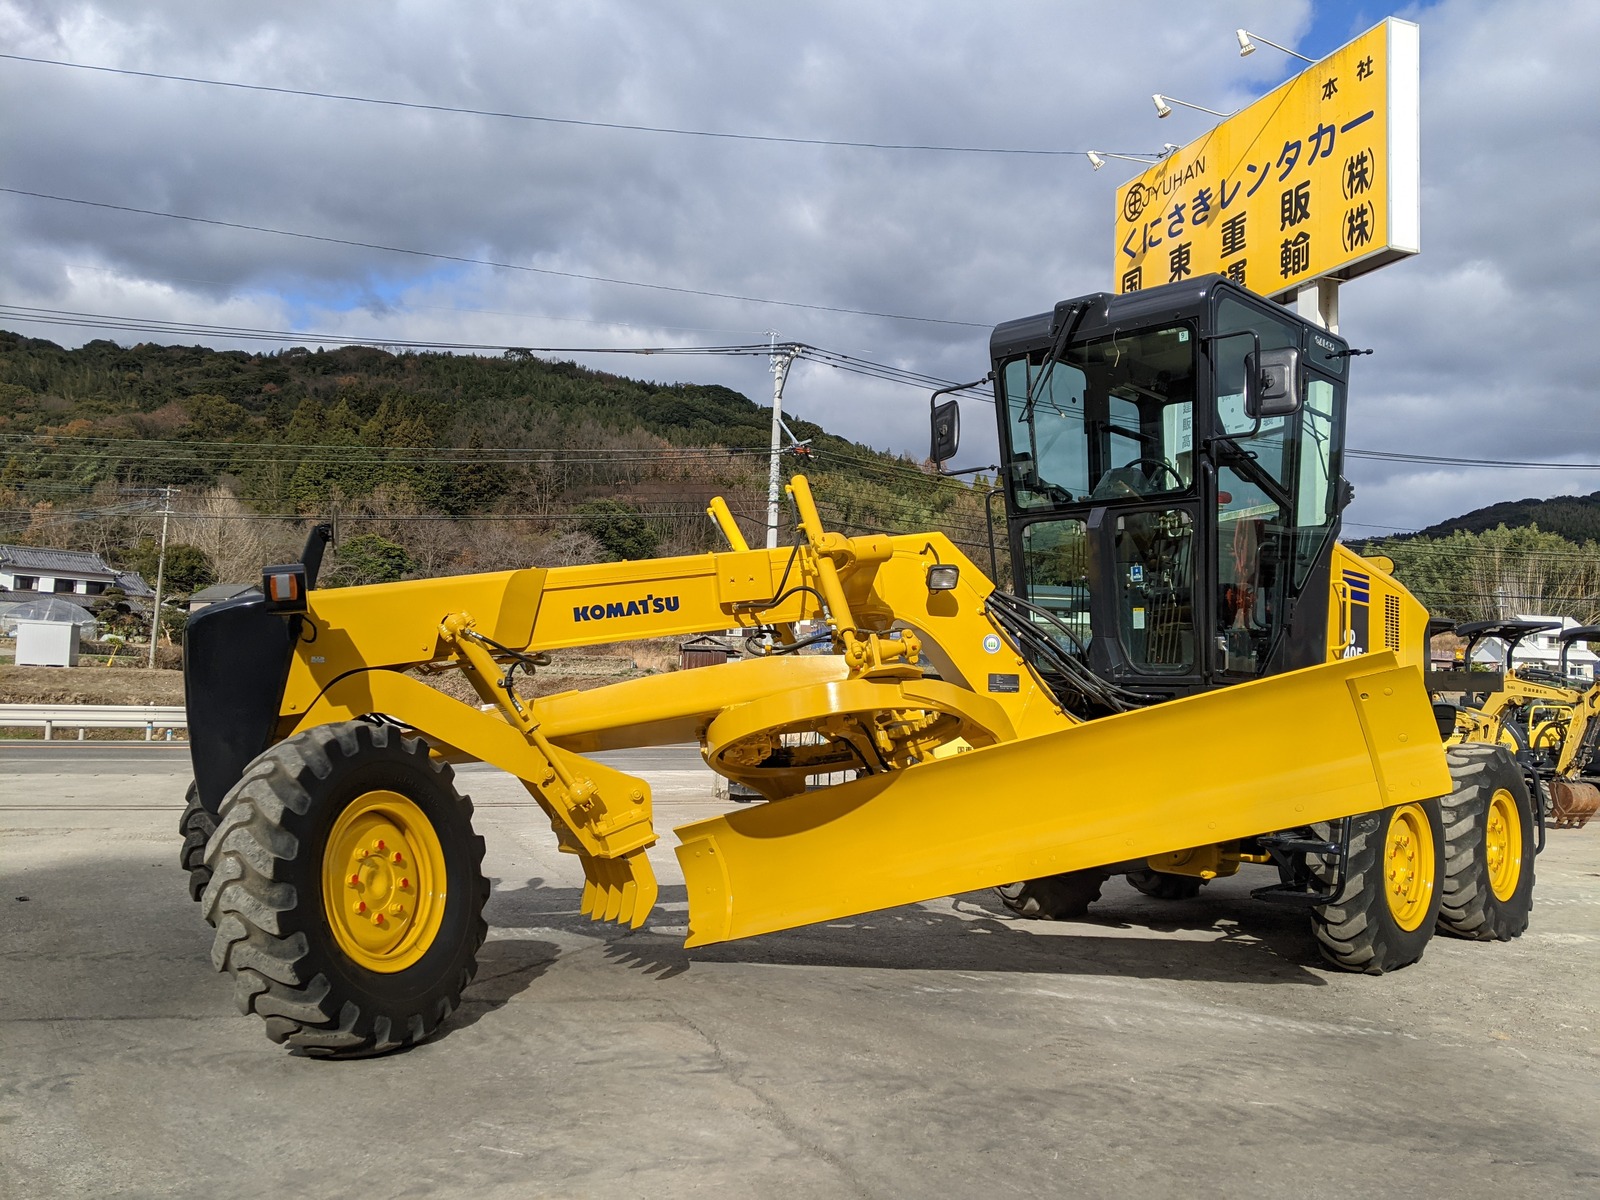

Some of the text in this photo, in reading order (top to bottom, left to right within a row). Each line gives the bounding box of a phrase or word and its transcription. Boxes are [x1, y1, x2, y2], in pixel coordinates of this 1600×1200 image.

[1322, 55, 1374, 101] 本社
[1122, 110, 1375, 259] くにさきレンタカー
[1142, 156, 1206, 208] JYUHAN
[573, 594, 680, 622] KOMATSU
